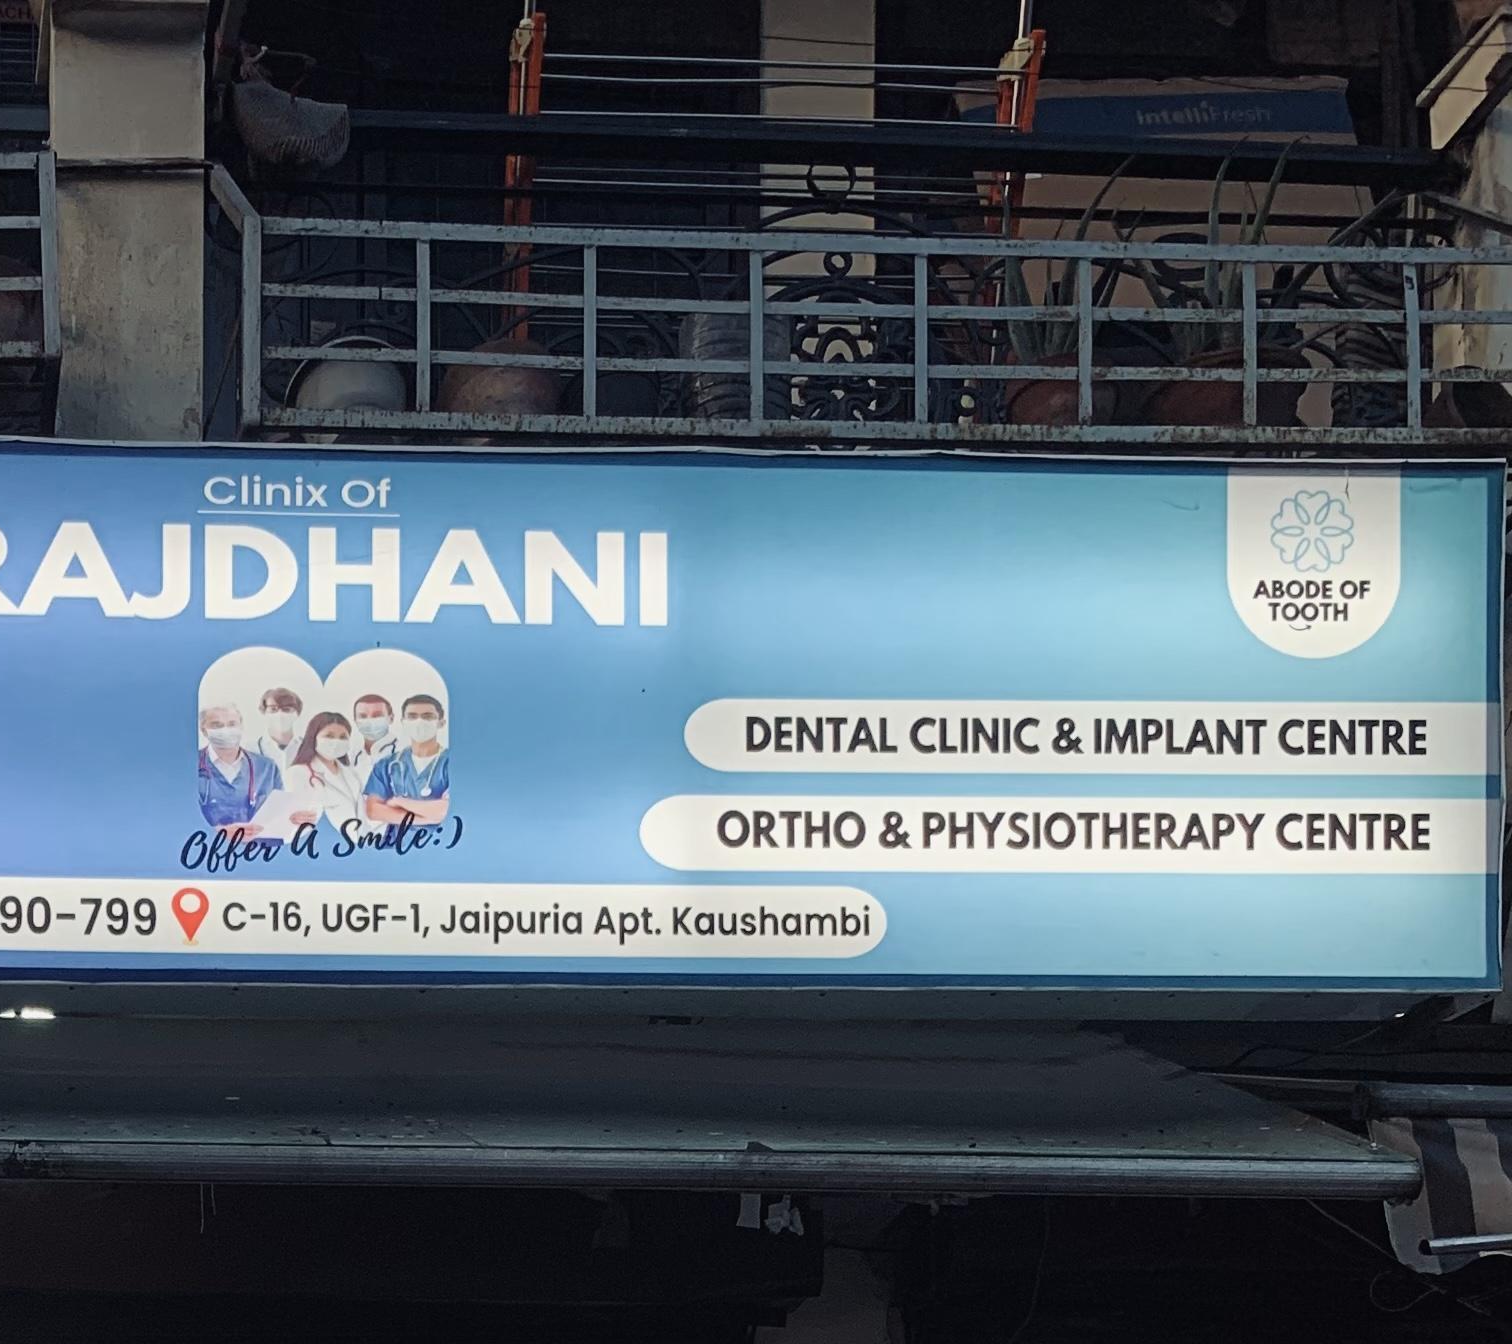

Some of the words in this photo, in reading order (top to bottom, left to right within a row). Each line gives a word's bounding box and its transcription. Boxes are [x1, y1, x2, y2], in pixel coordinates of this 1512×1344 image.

[203, 475, 328, 509] Clinix
[341, 477, 391, 509] Of
[1253, 579, 1335, 601] ABODE
[1339, 579, 1372, 601] OF
[1268, 602, 1350, 623] TOOTH
[745, 715, 899, 755] DENTAL
[909, 716, 1041, 756] CLINIC
[1051, 716, 1085, 756] &
[1093, 717, 1268, 757] IMPLANT
[1277, 717, 1429, 757] CENTRE
[180, 829, 281, 873] Offer
[291, 822, 320, 859] A
[716, 809, 867, 850] ORTHO
[877, 810, 911, 849] &
[921, 811, 1266, 852] PHYSIOTHERAPY
[1276, 812, 1433, 853] CENTRE
[222, 901, 312, 939] C-16,
[321, 901, 431, 941] UGF-1,
[439, 903, 586, 943] Jaipuria
[594, 905, 663, 944] Apt.
[672, 904, 873, 938] Kaushambi
